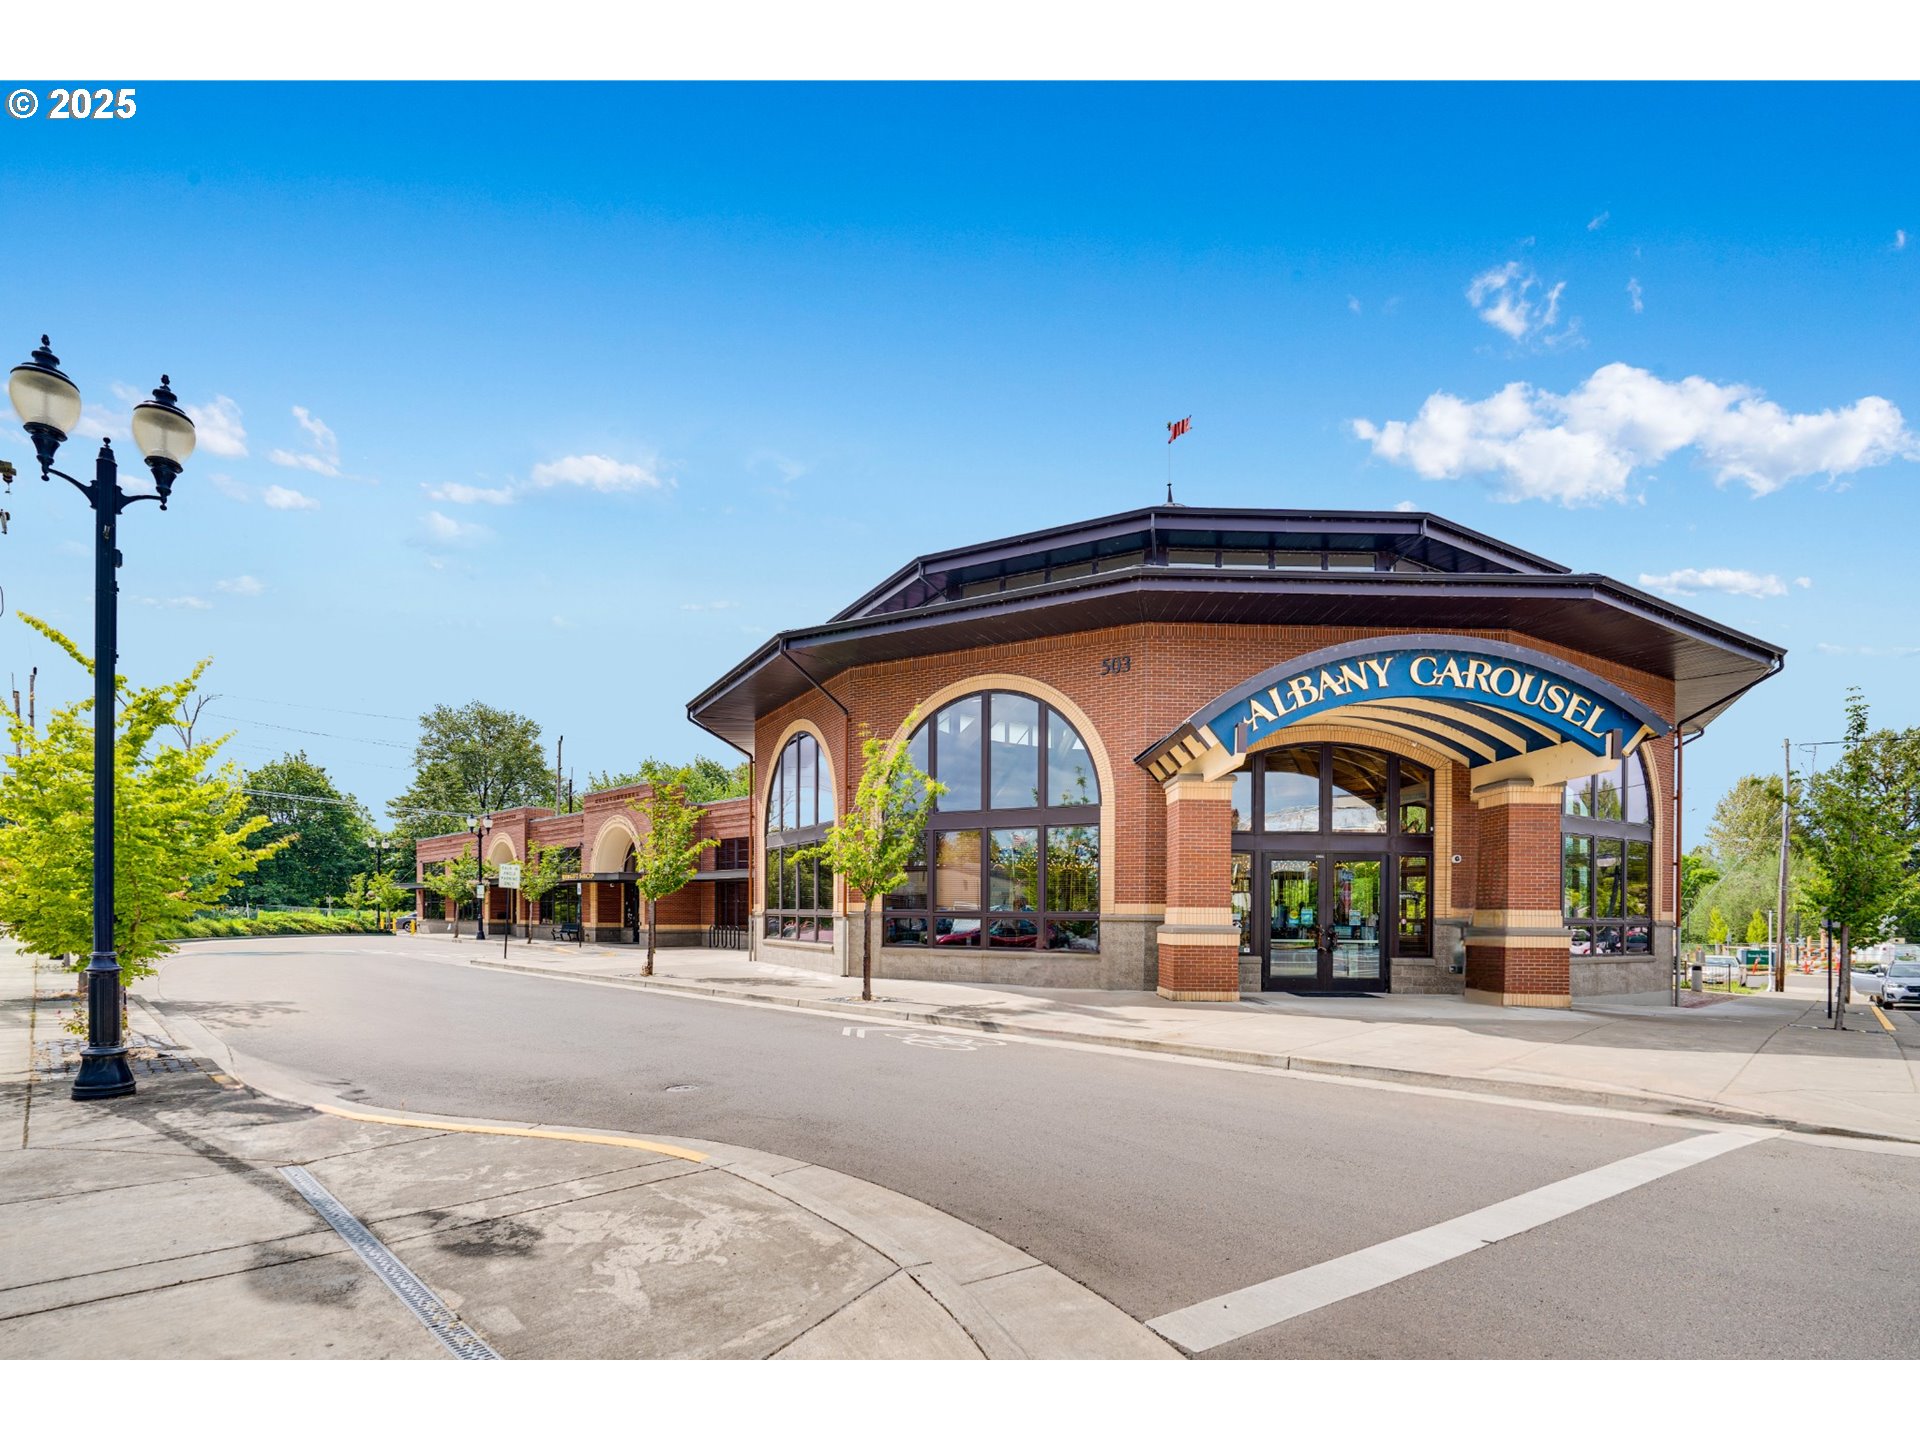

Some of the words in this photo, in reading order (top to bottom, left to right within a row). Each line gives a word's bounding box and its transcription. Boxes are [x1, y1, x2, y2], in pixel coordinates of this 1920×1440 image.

[1101, 656, 1131, 675] 503
[1243, 657, 1394, 732] ALBANY
[1409, 656, 1606, 738] CAROUSEL
